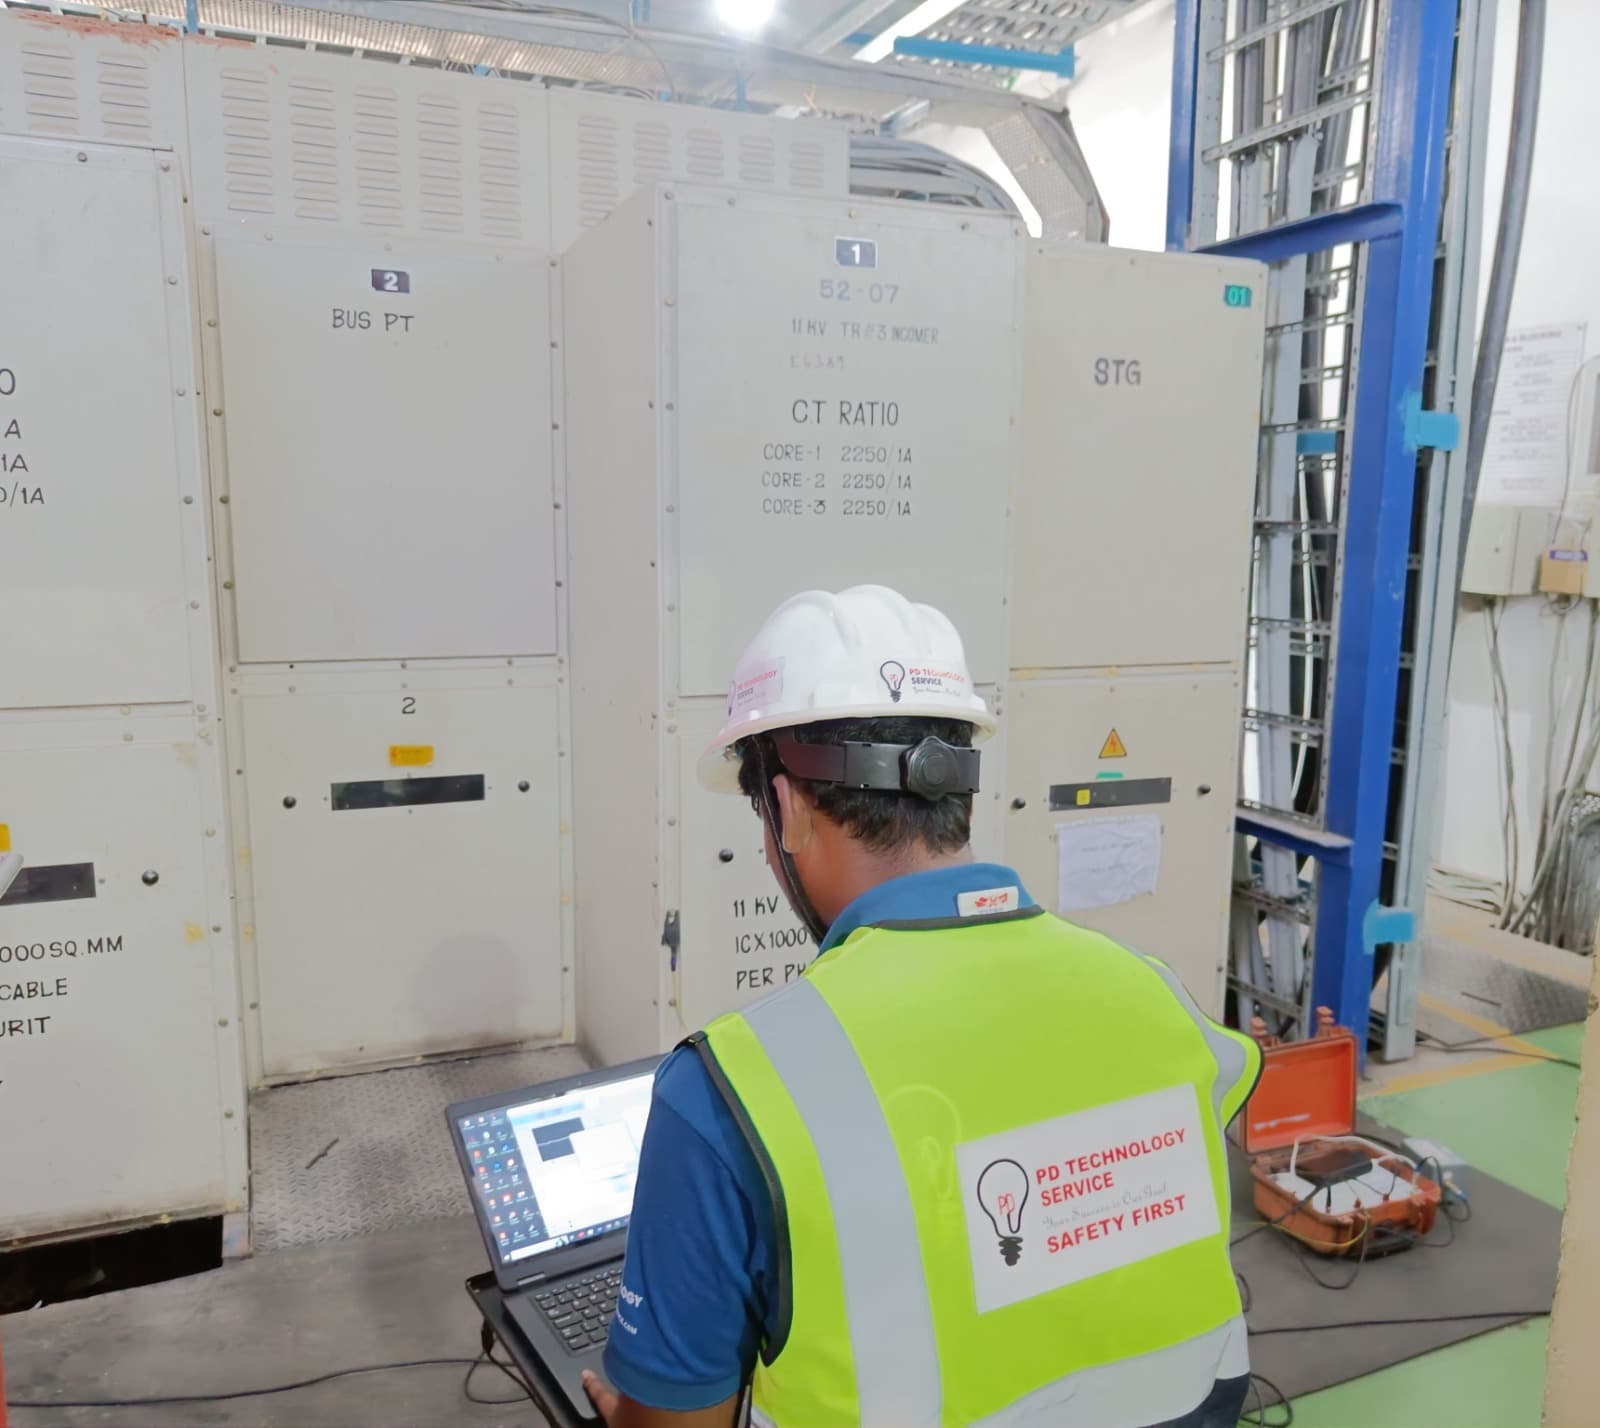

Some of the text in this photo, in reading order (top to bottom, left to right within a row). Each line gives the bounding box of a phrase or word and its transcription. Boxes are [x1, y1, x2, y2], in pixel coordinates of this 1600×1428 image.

[851, 243, 861, 265] 1
[384, 271, 399, 291] 2
[819, 279, 900, 304] 52-07
[1228, 285, 1248, 306] 01
[332, 308, 416, 332] BUS PT
[1094, 357, 1142, 386] STG
[792, 399, 899, 426] CT RATIO
[762, 443, 822, 462] CORE-1
[761, 471, 825, 489] CORE-2
[762, 497, 826, 516] CORE-3
[401, 697, 416, 715] 2
[733, 896, 778, 918] 11 KV
[736, 967, 773, 990] PER
[1036, 1128, 1187, 1185] PD TECHNOLOGY
[1040, 1171, 1115, 1207] SERVICE
[1047, 1194, 1187, 1254] SAFETY FIRST
